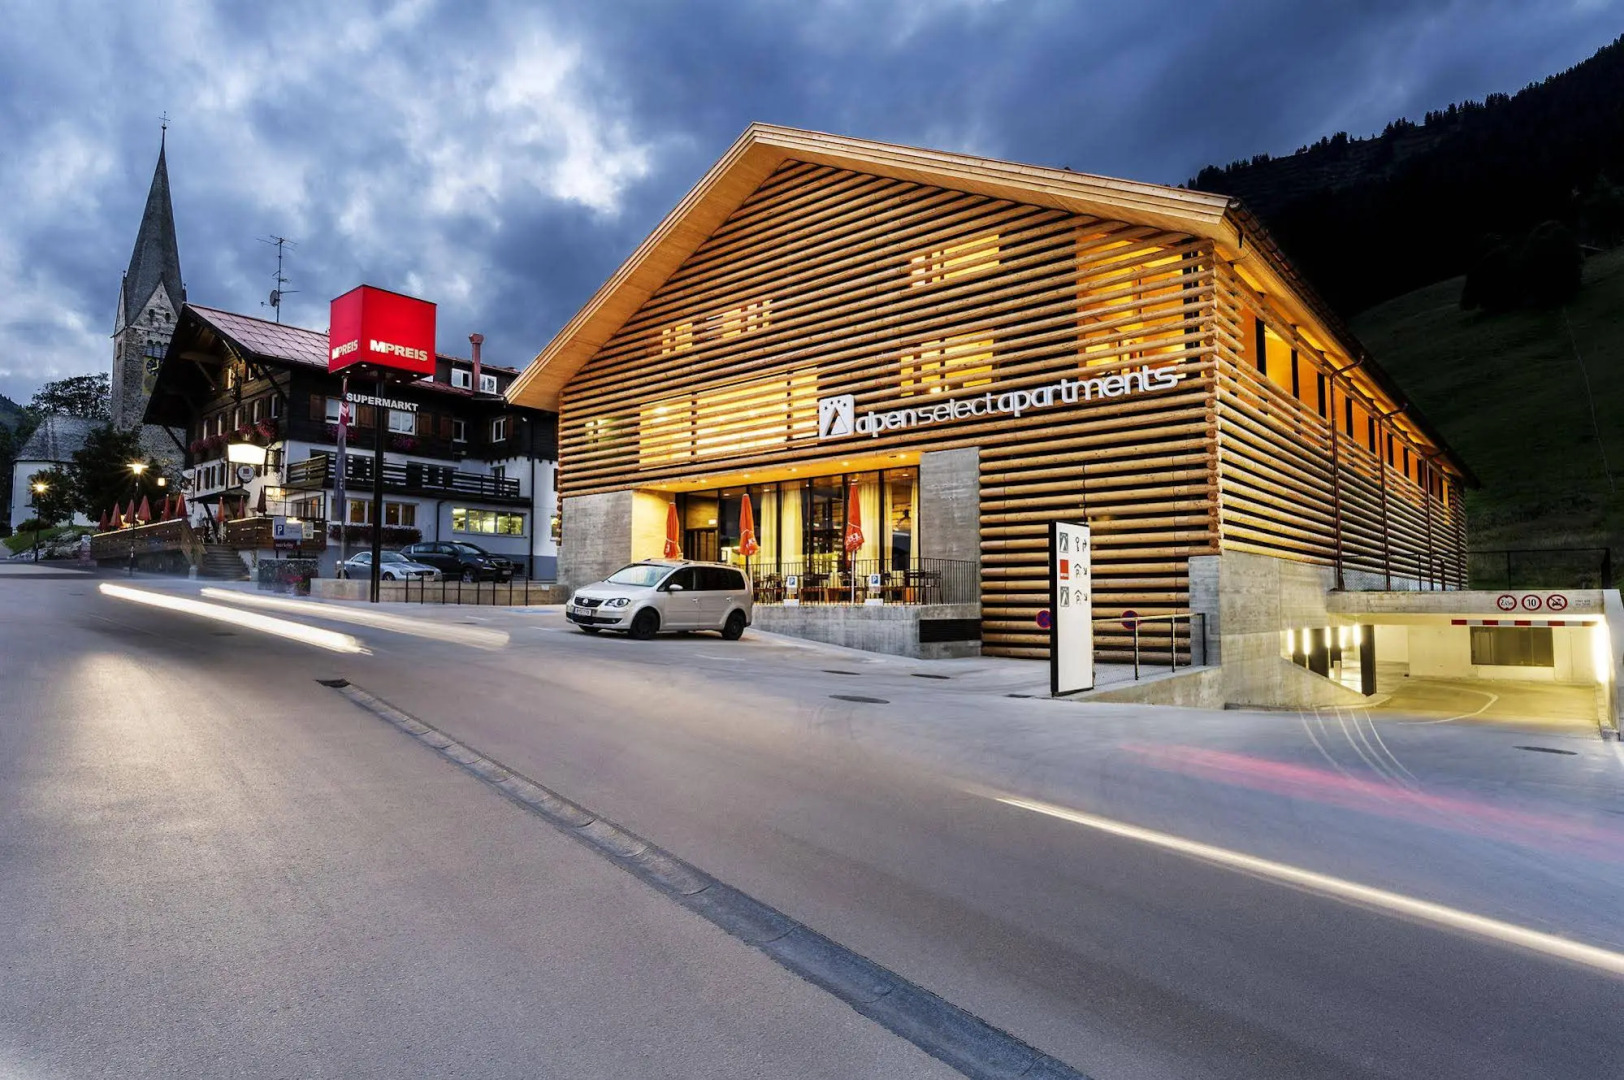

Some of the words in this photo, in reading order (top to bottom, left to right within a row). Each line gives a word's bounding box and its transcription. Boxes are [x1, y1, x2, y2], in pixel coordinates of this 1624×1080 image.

[331, 340, 358, 360] MPREIS
[370, 339, 428, 361] MPREIS
[346, 392, 419, 412] SUPERMARKT
[1527, 598, 1537, 607] 10
